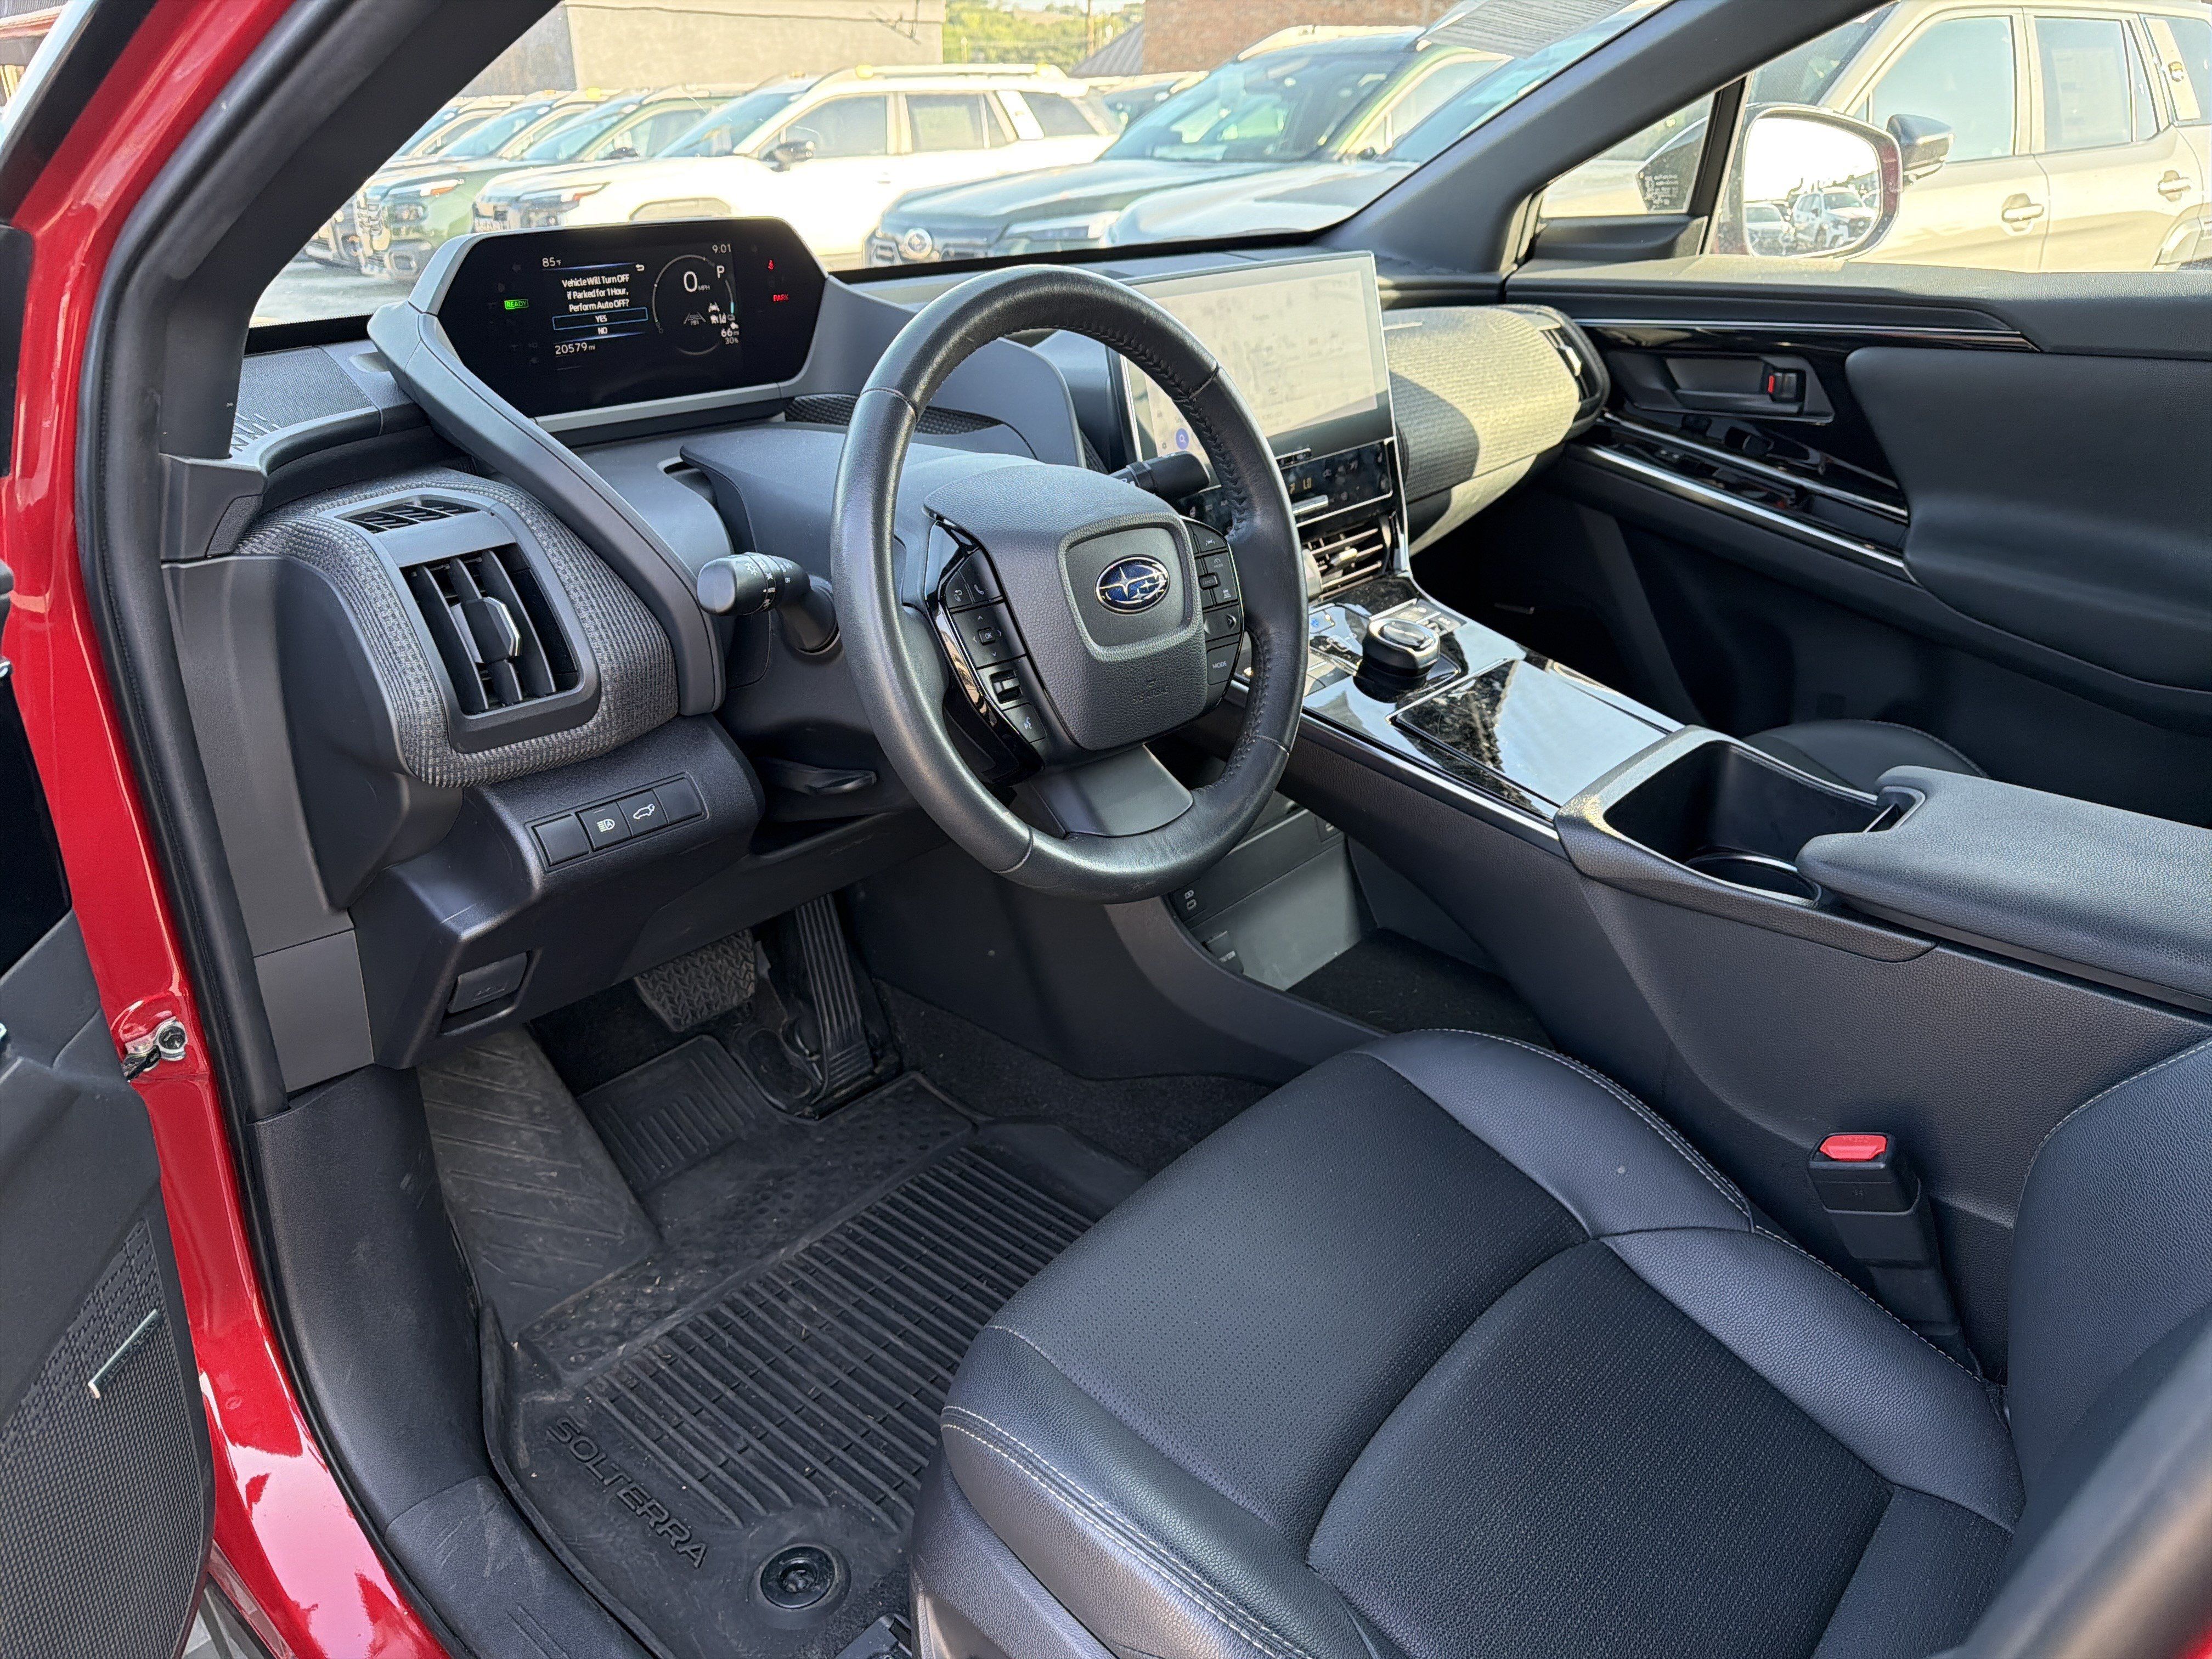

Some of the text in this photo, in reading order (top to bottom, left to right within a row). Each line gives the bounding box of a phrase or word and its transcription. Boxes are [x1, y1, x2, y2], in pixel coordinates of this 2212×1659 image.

[712, 244, 731, 253] 9:01
[716, 265, 725, 279] P
[562, 274, 630, 287] Vehicle Will Turn OFF
[684, 271, 697, 292] 0
[573, 289, 596, 300] Parked
[596, 288, 606, 297] for
[606, 287, 611, 296] 1
[611, 287, 629, 296] Hour,
[569, 298, 630, 313] Perform Auto OFF?
[595, 314, 607, 323] YES
[721, 328, 732, 337] 66
[555, 342, 587, 354] 20579
[1212, 661, 1227, 669] MODE
[546, 1418, 707, 1569] SOLTERRA
